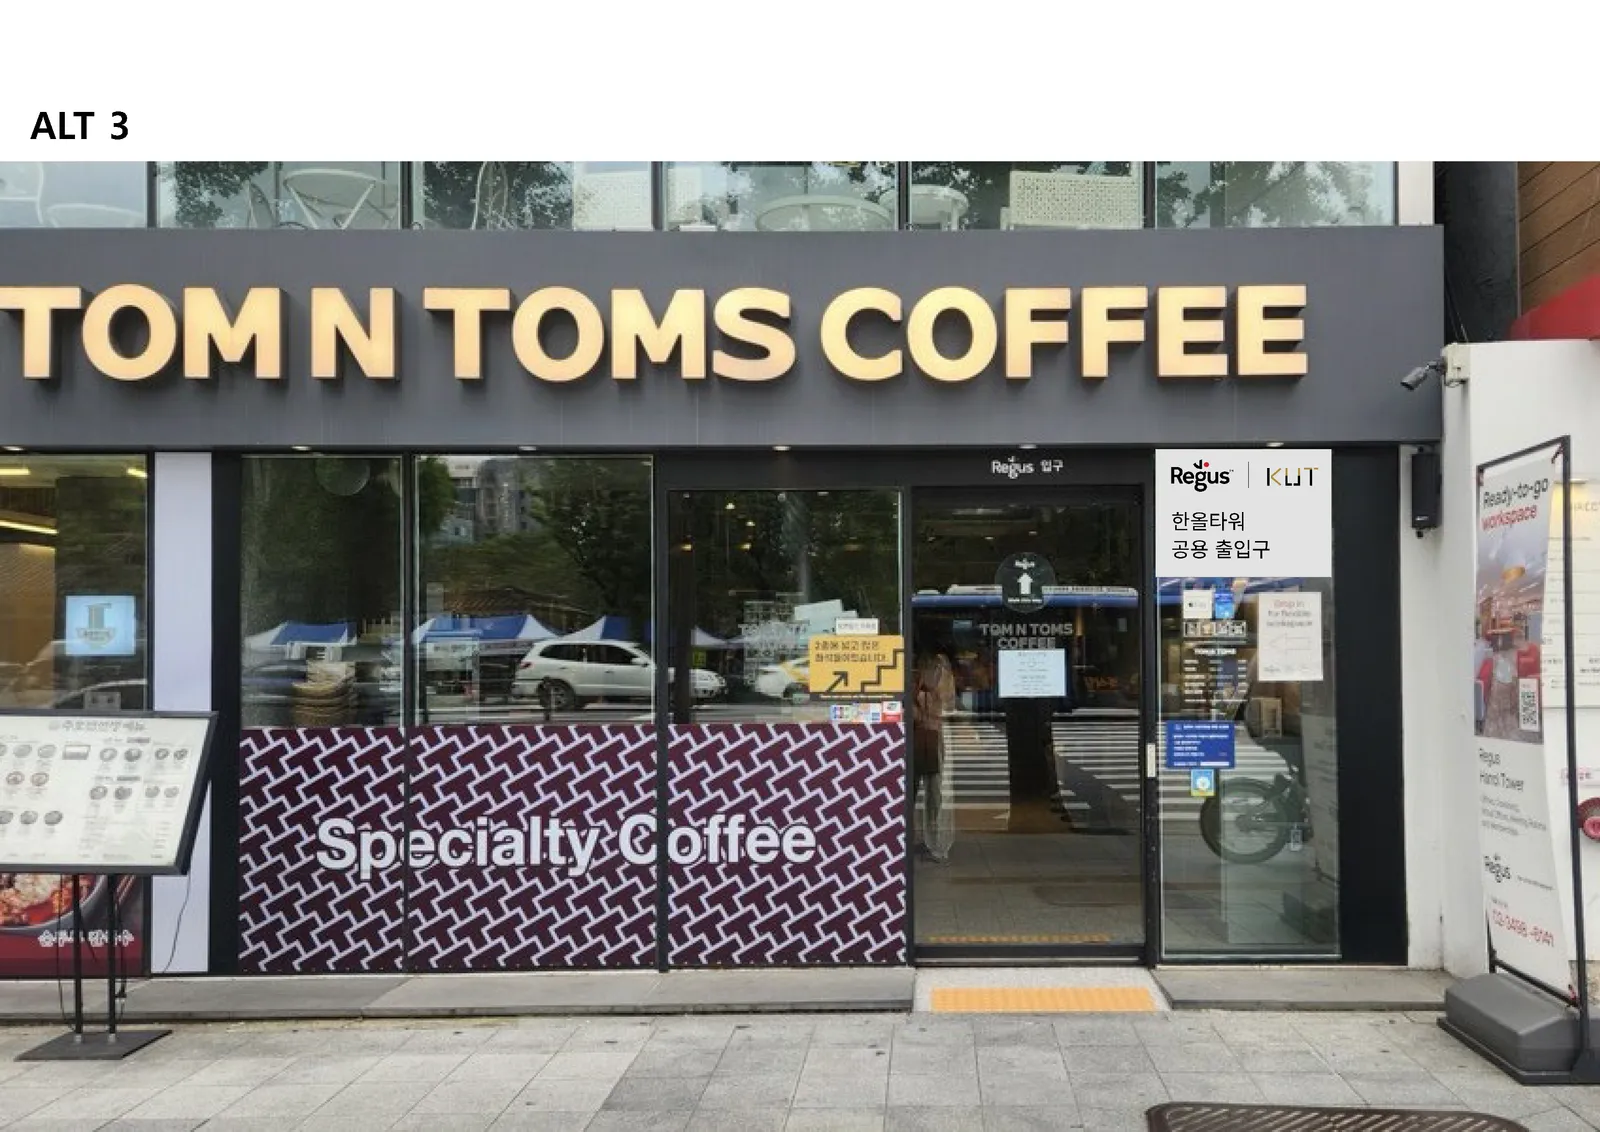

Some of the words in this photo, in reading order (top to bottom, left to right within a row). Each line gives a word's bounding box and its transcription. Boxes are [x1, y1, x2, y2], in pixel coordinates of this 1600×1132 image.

[0, 284, 284, 382] TOM
[310, 287, 397, 381] N
[424, 285, 797, 383] TOMS
[820, 284, 1309, 382] COFFEE
[991, 456, 1035, 480] Regus
[1171, 459, 1231, 493] Regus
[1266, 467, 1319, 487] KUT
[1483, 478, 1549, 509] Ready-to-go
[1172, 511, 1245, 532] 한올타워
[1481, 505, 1538, 532] workspace
[1172, 539, 1209, 560] 공용
[1215, 539, 1271, 560] 출입구
[979, 623, 1013, 636] TOM
[1015, 624, 1027, 635] N
[1029, 624, 1073, 635] TOMS
[998, 637, 1056, 649] COFFEE
[315, 816, 601, 879] Specialty
[619, 814, 818, 866] Coffee
